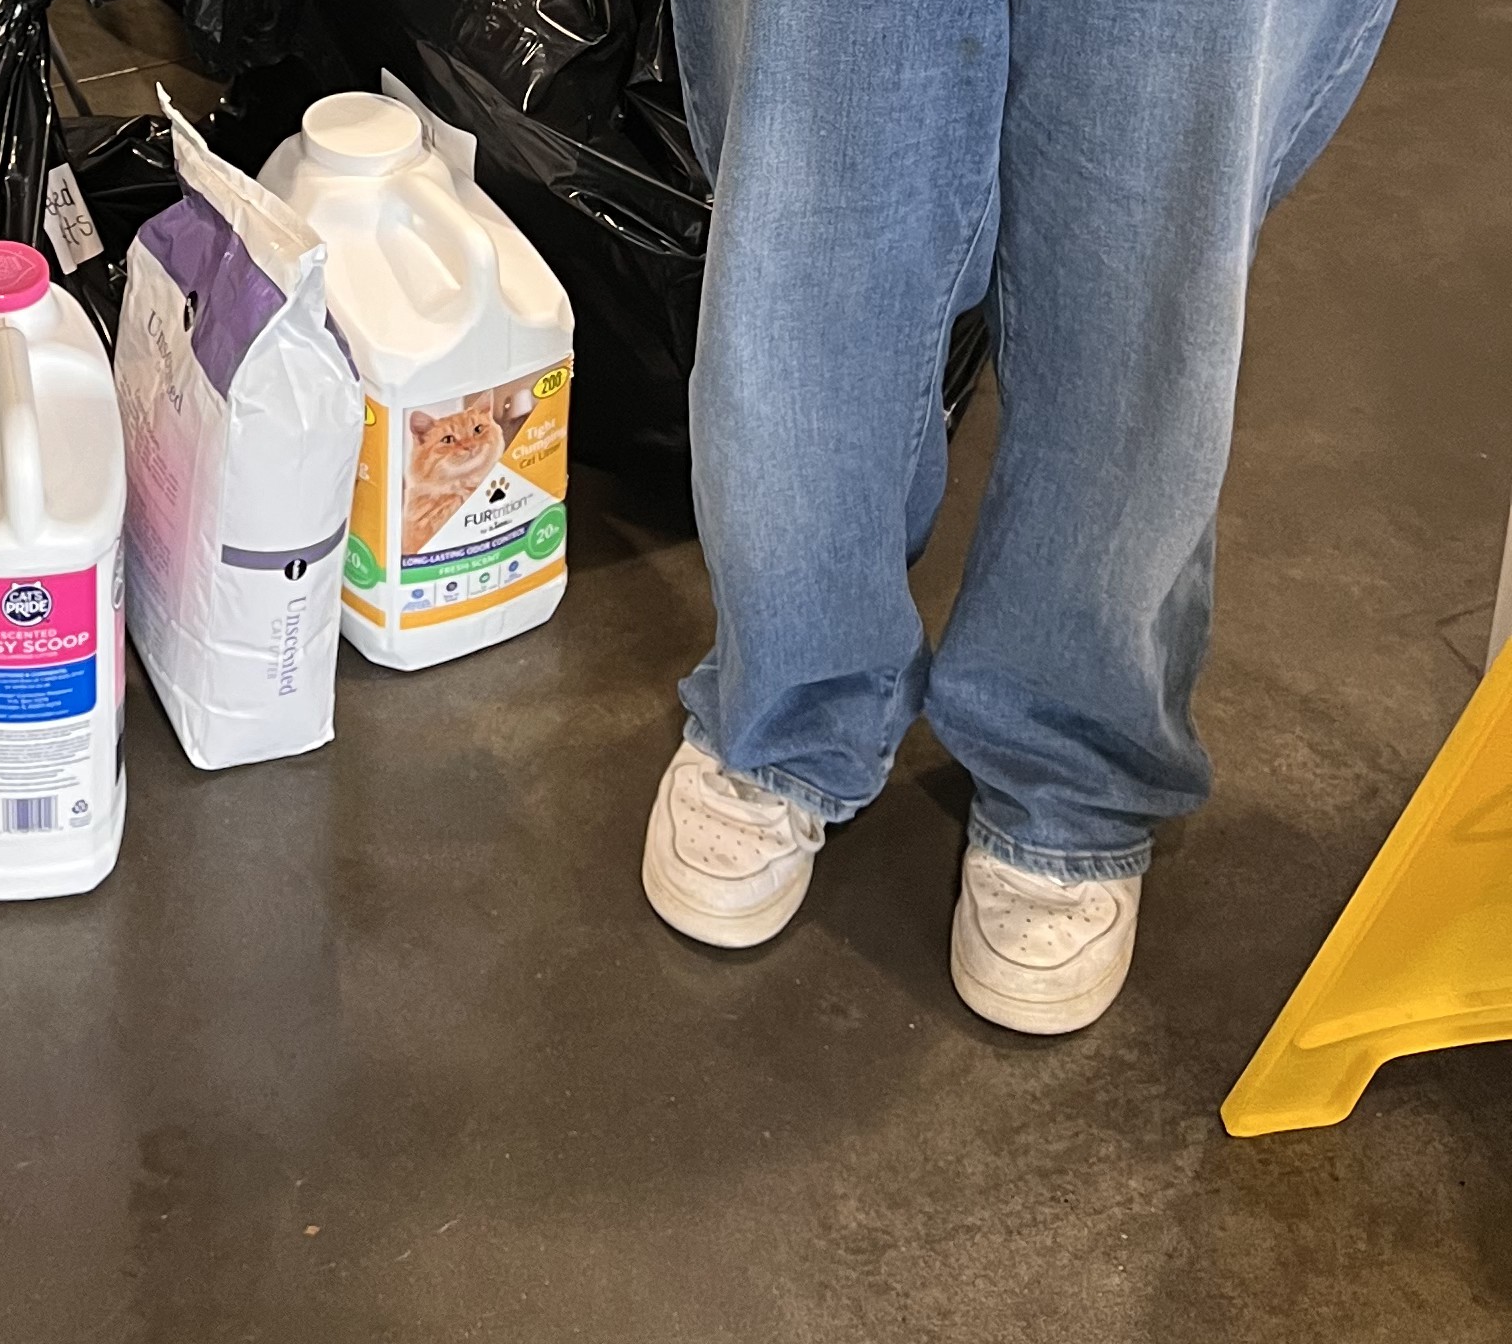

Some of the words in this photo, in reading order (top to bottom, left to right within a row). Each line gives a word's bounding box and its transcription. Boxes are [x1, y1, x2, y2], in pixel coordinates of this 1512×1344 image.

[5, 600, 48, 617] PRIDE
[0, 629, 57, 640] SCENTED
[23, 631, 90, 652] SCOOP
[278, 596, 307, 697] Unscented
